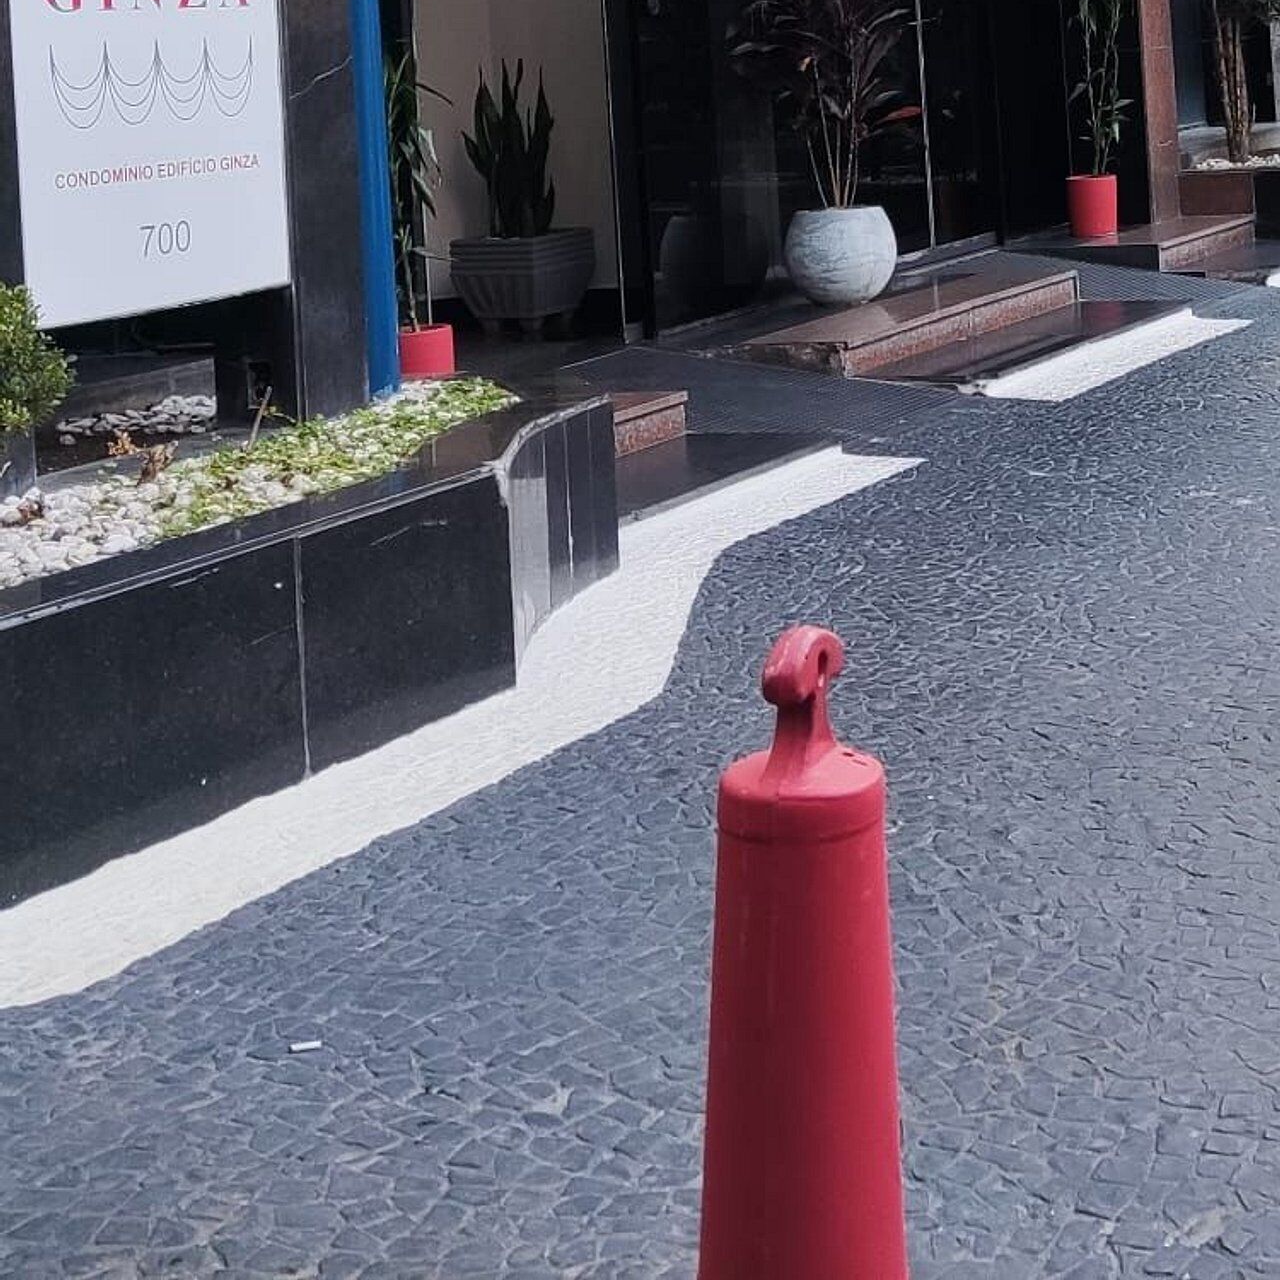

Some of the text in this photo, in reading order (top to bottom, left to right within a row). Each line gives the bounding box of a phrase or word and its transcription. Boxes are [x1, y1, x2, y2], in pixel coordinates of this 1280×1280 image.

[157, 156, 217, 179] EDIFÍCIO
[220, 153, 260, 171] GINZA
[140, 220, 191, 258] 700
